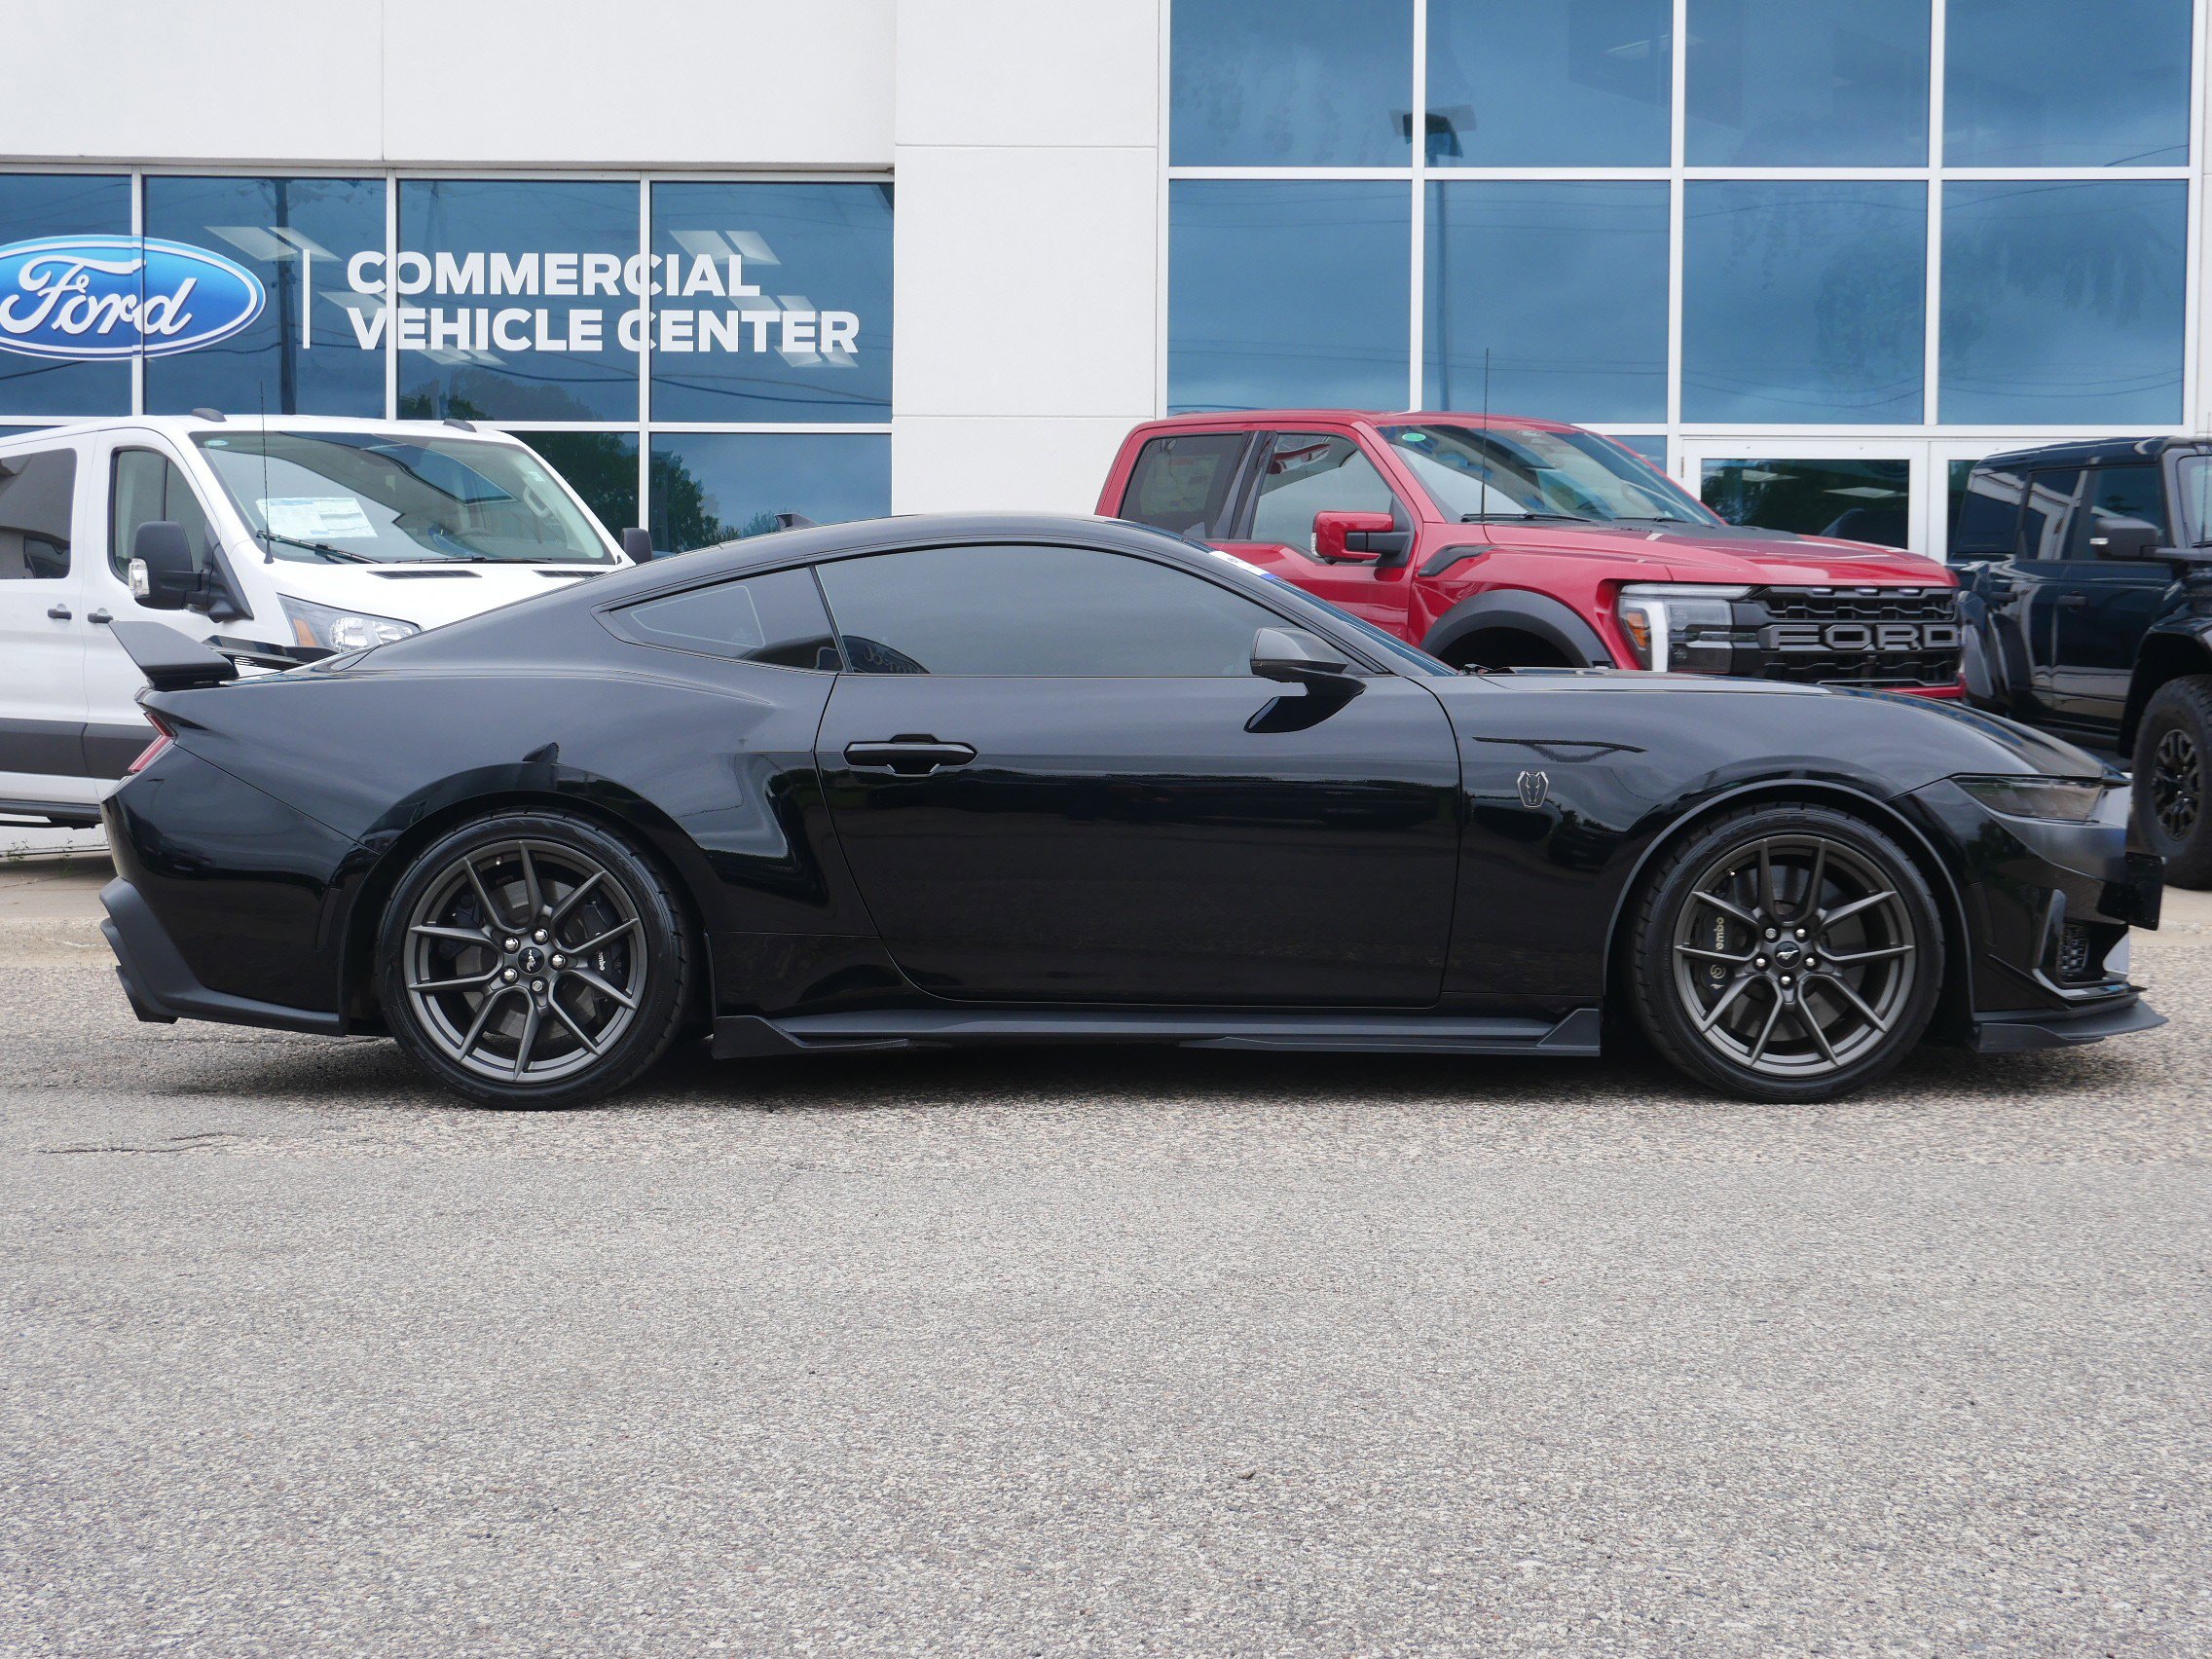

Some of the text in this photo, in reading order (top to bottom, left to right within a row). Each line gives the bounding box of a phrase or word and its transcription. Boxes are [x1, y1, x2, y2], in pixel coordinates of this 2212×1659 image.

[0, 255, 198, 335] Ford
[347, 250, 761, 297] COMMERCIAL
[347, 307, 860, 353] VEHICLE CENTER
[1762, 623, 1961, 651] FORD
